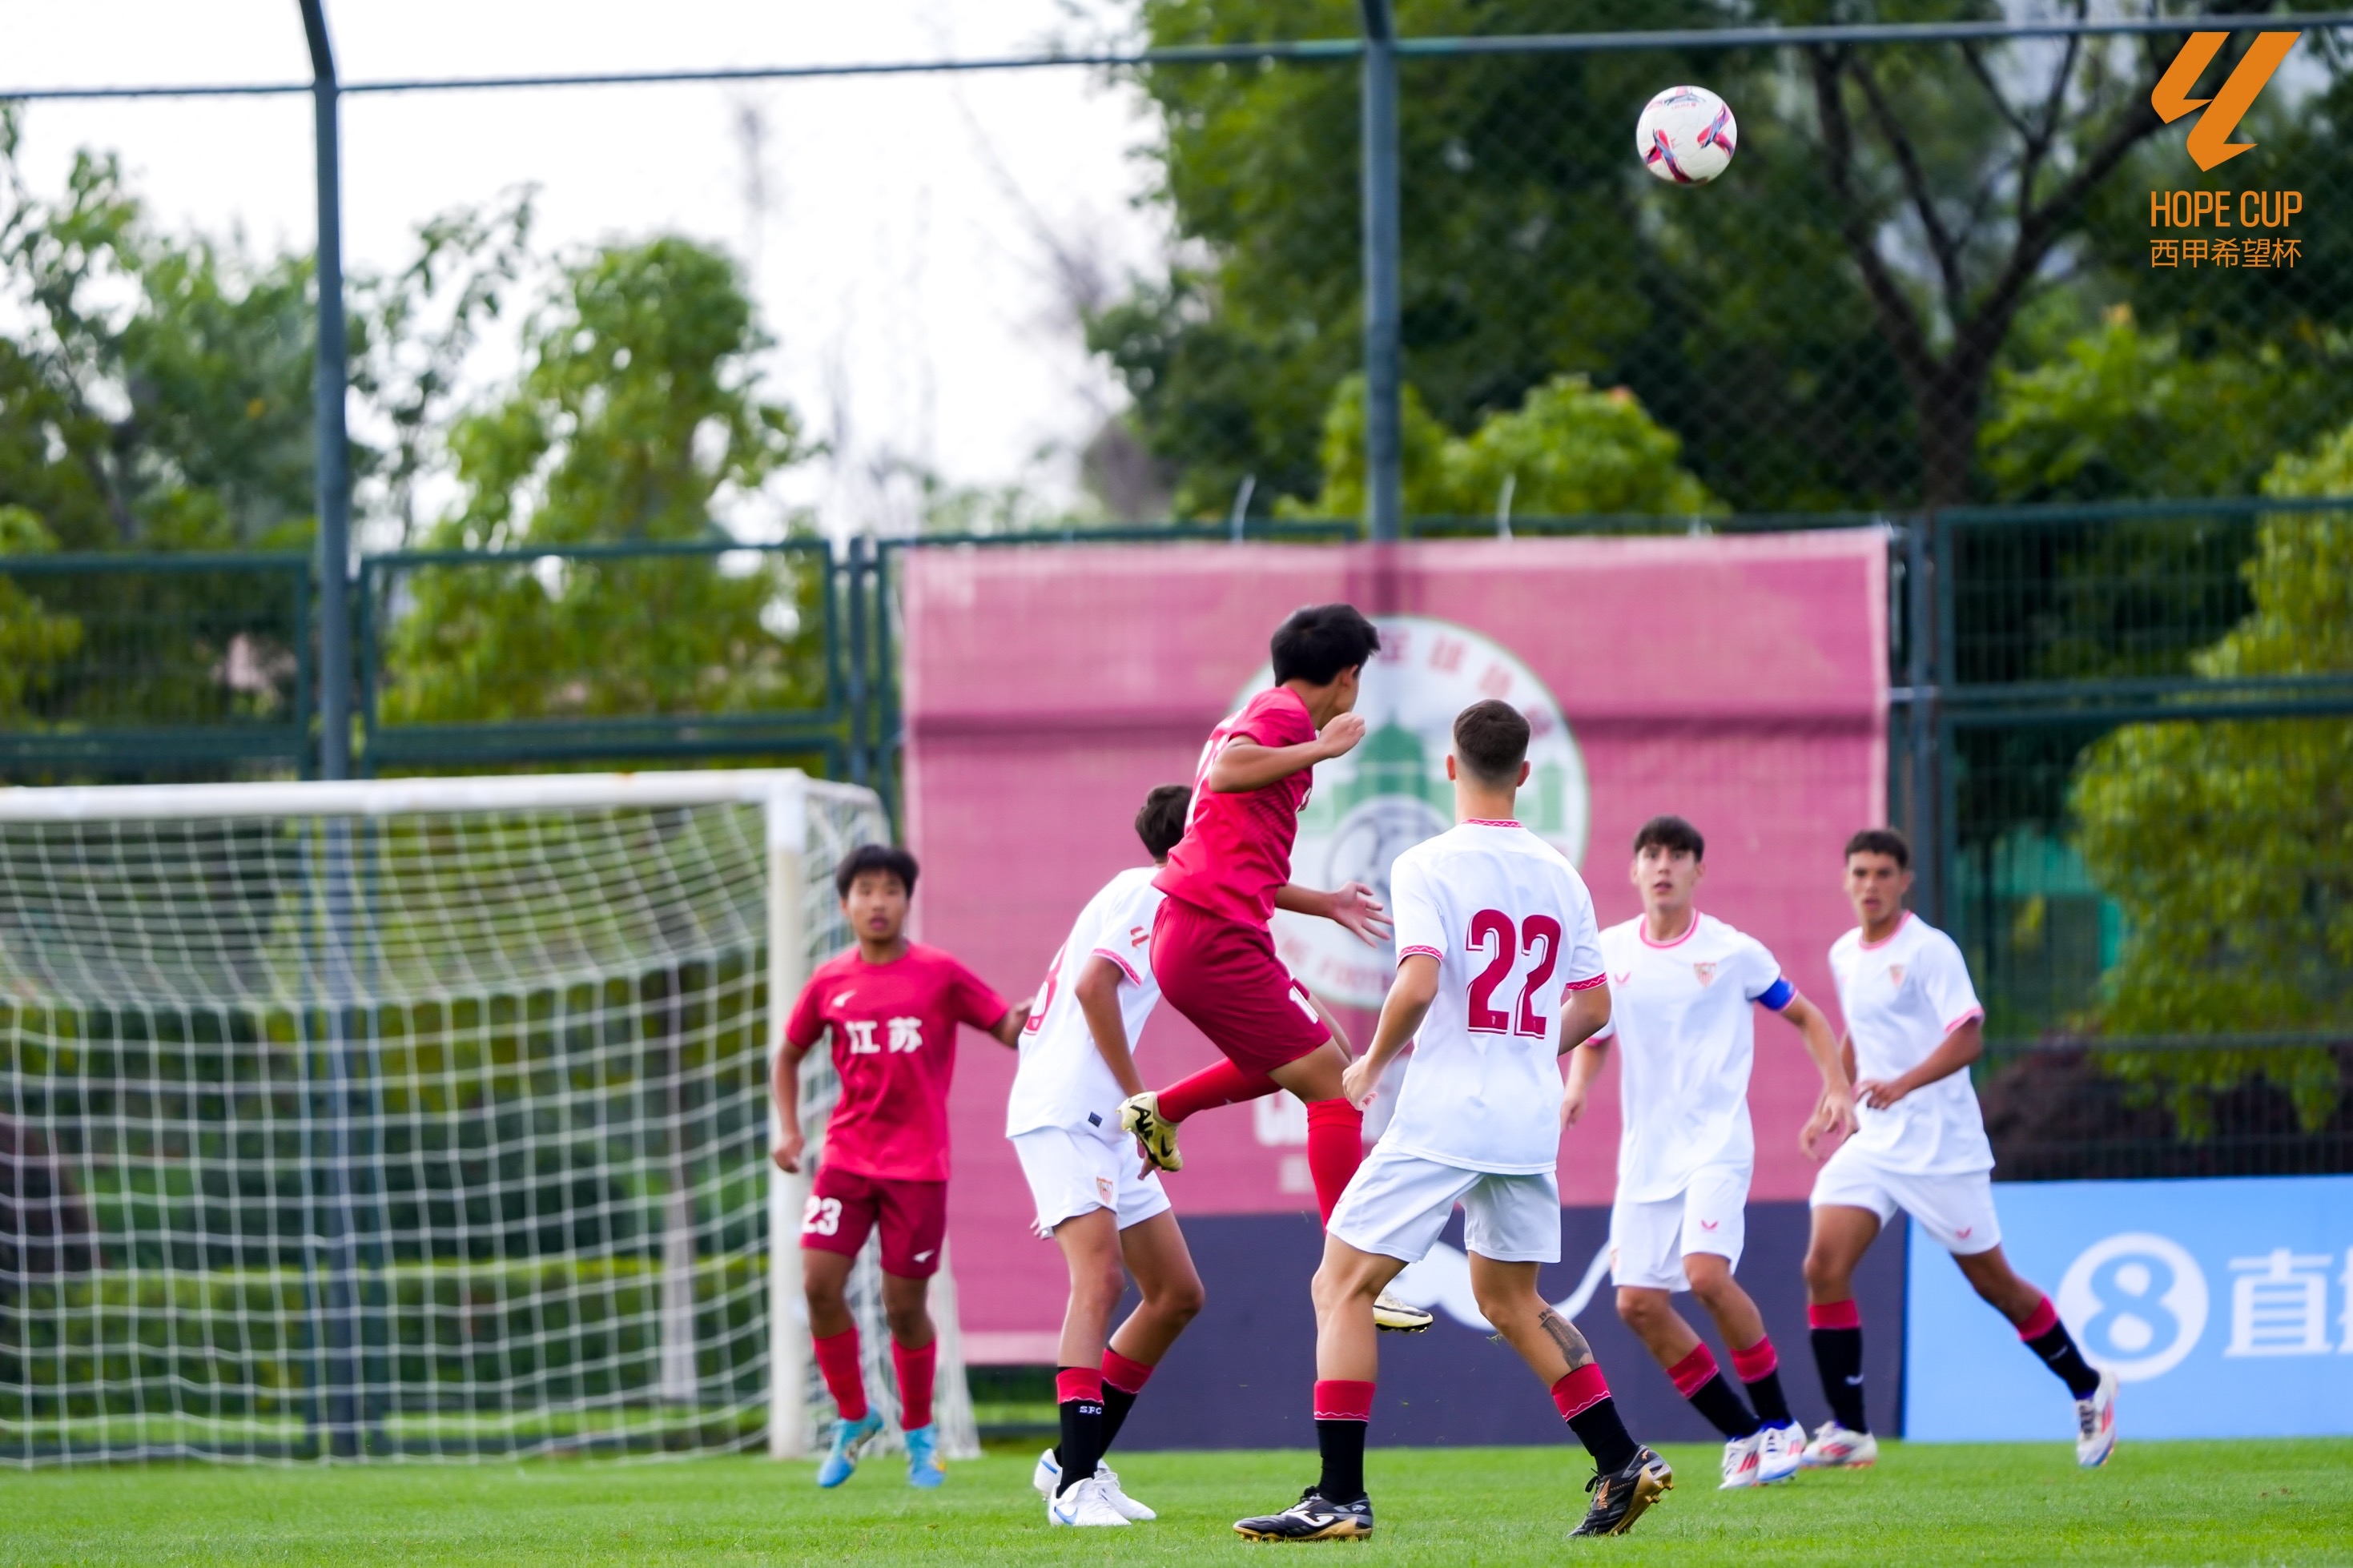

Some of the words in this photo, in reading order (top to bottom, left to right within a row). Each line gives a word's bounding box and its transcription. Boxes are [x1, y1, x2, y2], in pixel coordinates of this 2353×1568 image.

[1466, 909, 1561, 1039] 22
[845, 1016, 923, 1054] 江苏
[801, 1195, 843, 1236] 23
[1079, 1405, 1102, 1414] SFC
